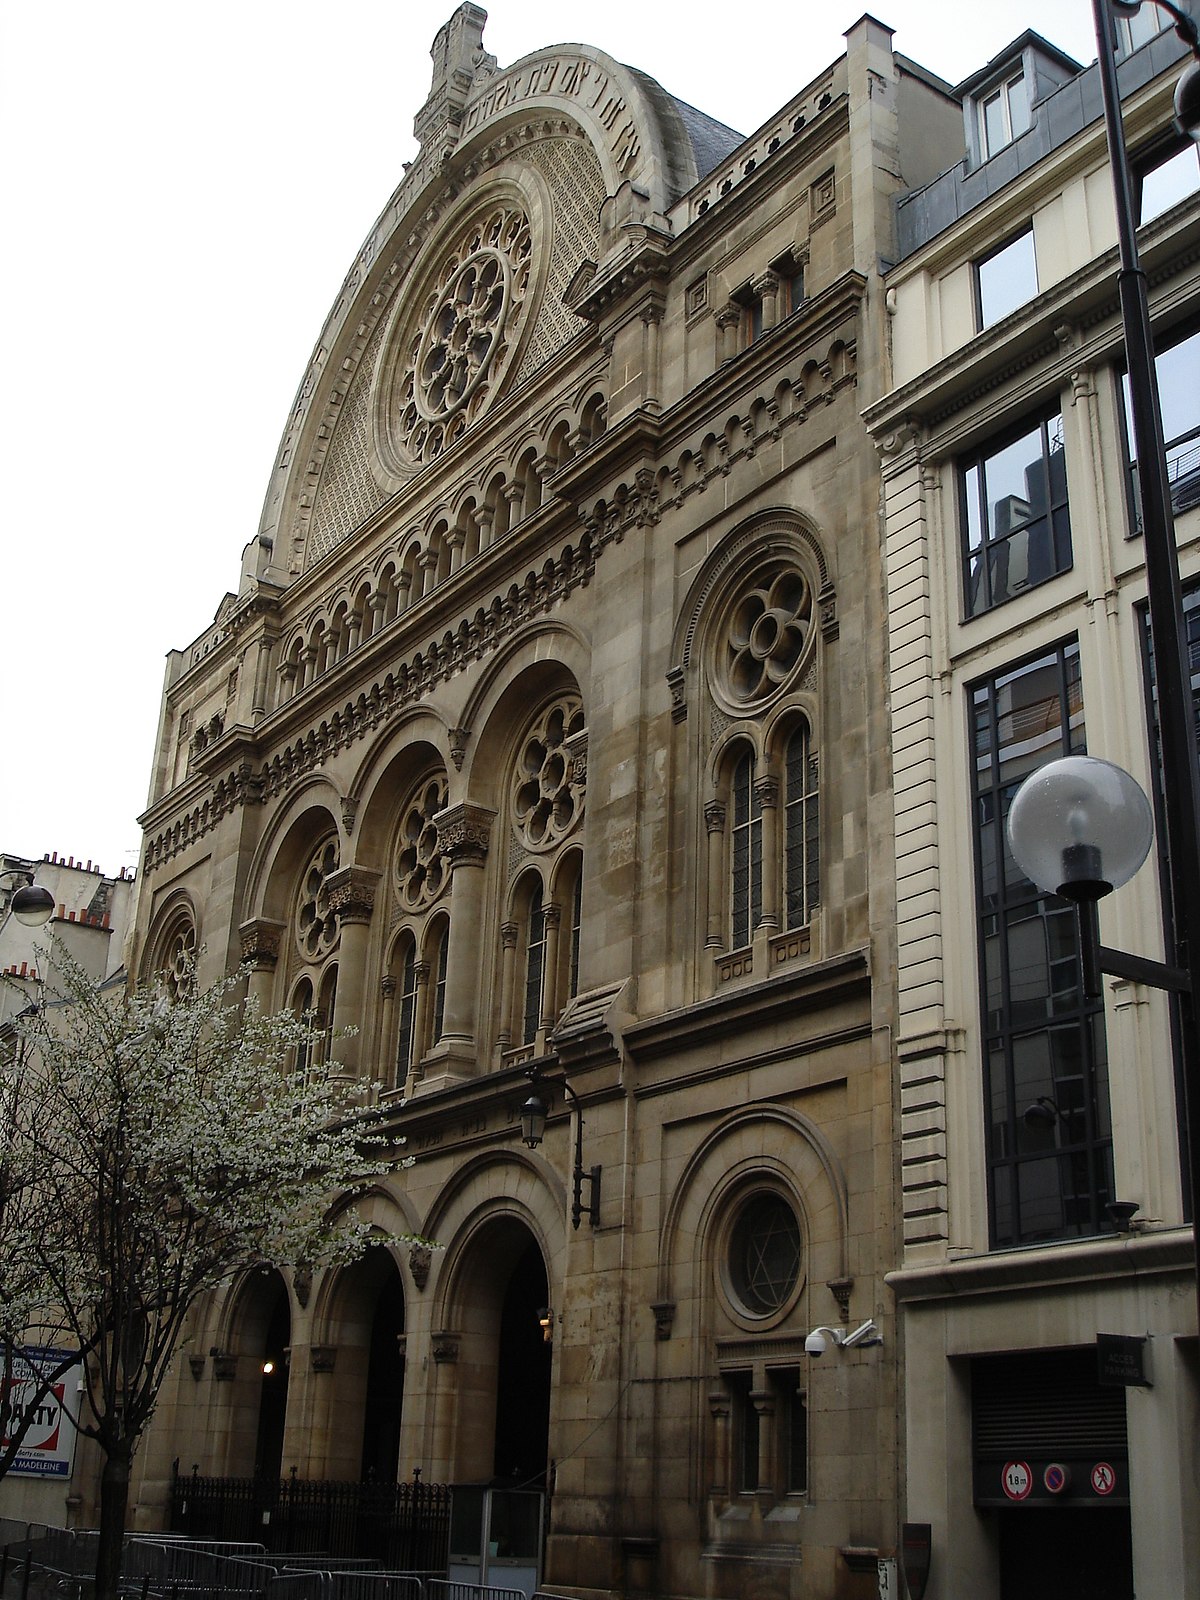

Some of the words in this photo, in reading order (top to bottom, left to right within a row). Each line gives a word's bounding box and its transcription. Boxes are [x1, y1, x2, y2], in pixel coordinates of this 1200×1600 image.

[1104, 1365, 1140, 1378] PARKING
[1, 1402, 58, 1426] ATY
[18, 1460, 60, 1471] MADELEINE
